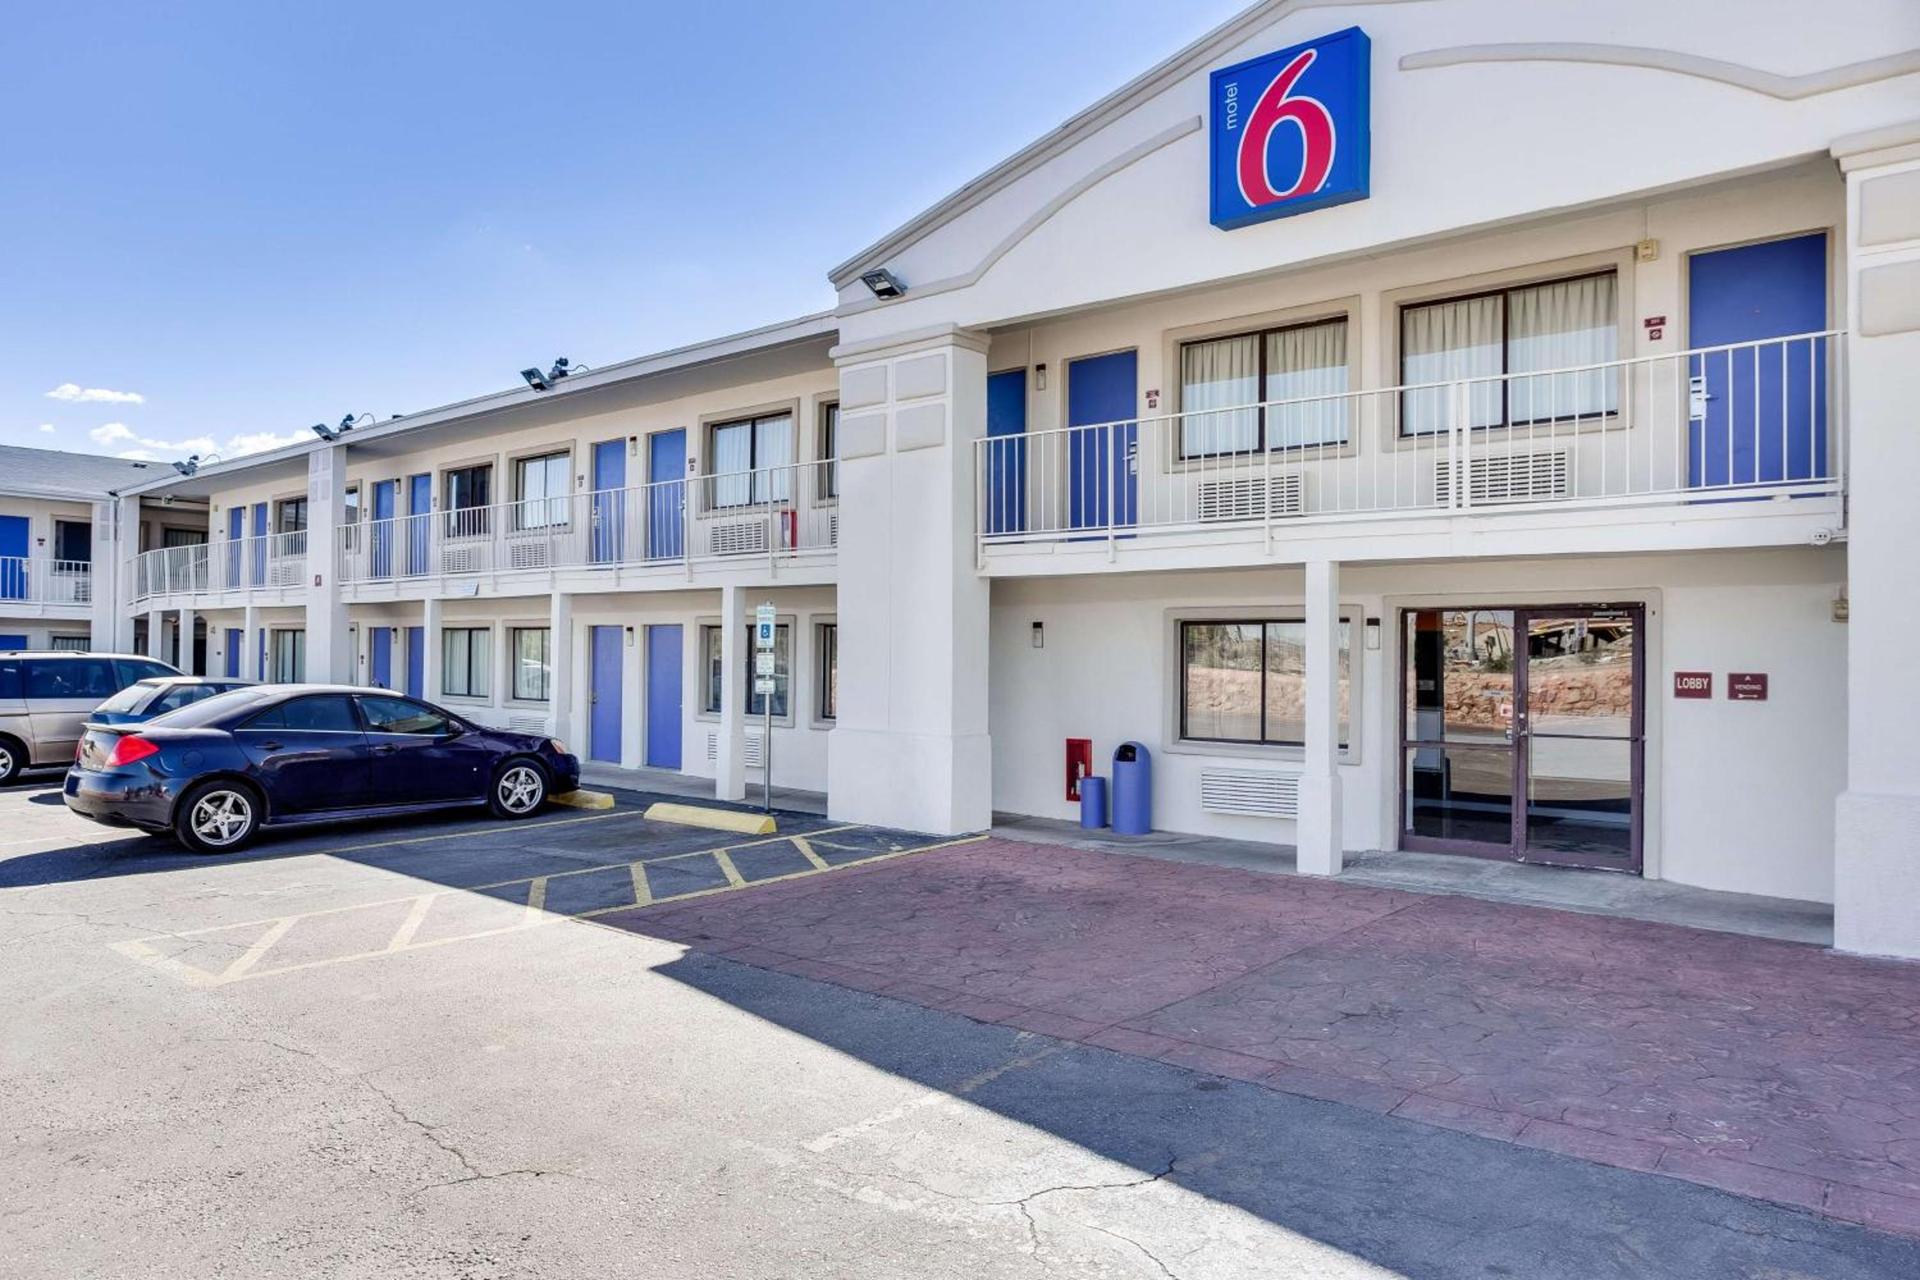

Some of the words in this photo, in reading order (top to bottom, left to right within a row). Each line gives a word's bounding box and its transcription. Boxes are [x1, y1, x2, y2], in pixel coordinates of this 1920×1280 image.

[1225, 82, 1238, 130] motel
[1236, 48, 1336, 208] 6
[1677, 677, 1709, 690] LOBBY
